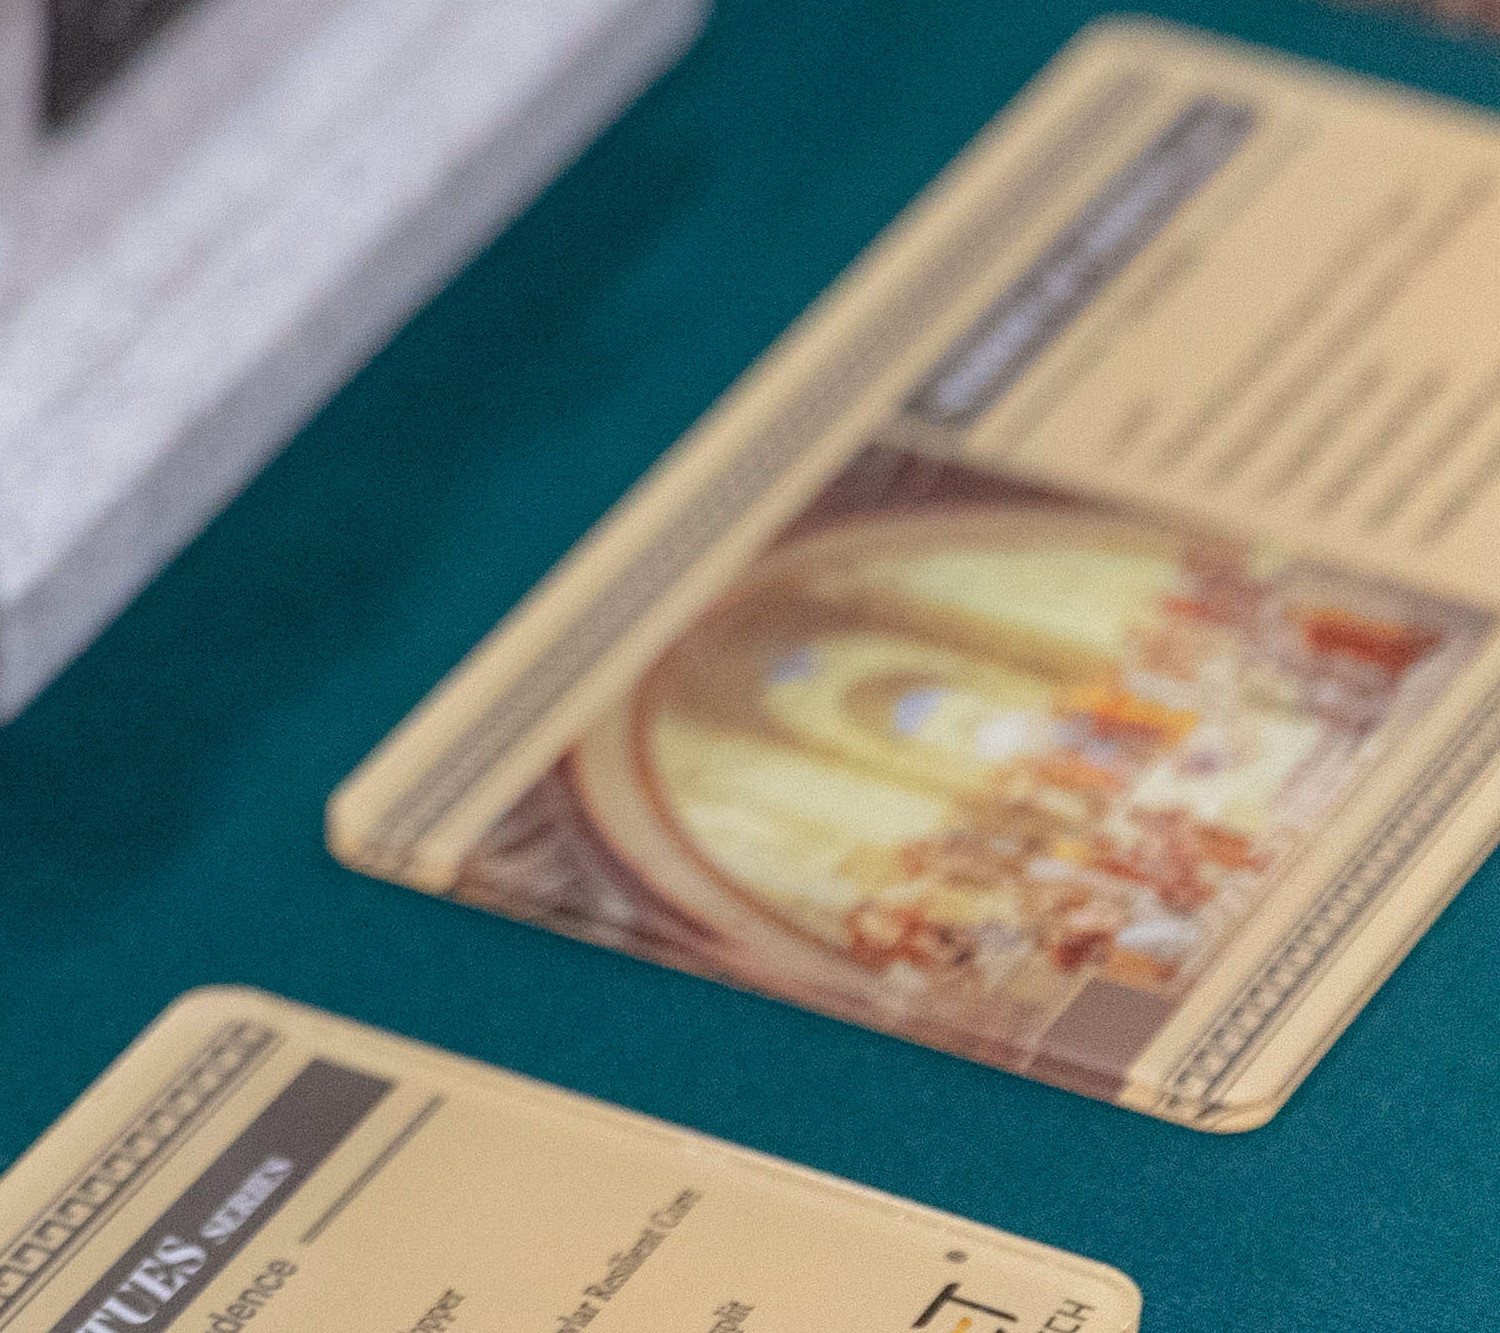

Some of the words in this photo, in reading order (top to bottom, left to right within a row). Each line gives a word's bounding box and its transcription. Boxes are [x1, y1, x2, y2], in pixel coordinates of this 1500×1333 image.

[76, 1236, 207, 1333] TUES
[201, 1157, 294, 1245] SERIES
[204, 1258, 298, 1333] dence
[1038, 1299, 1097, 1333] CH
